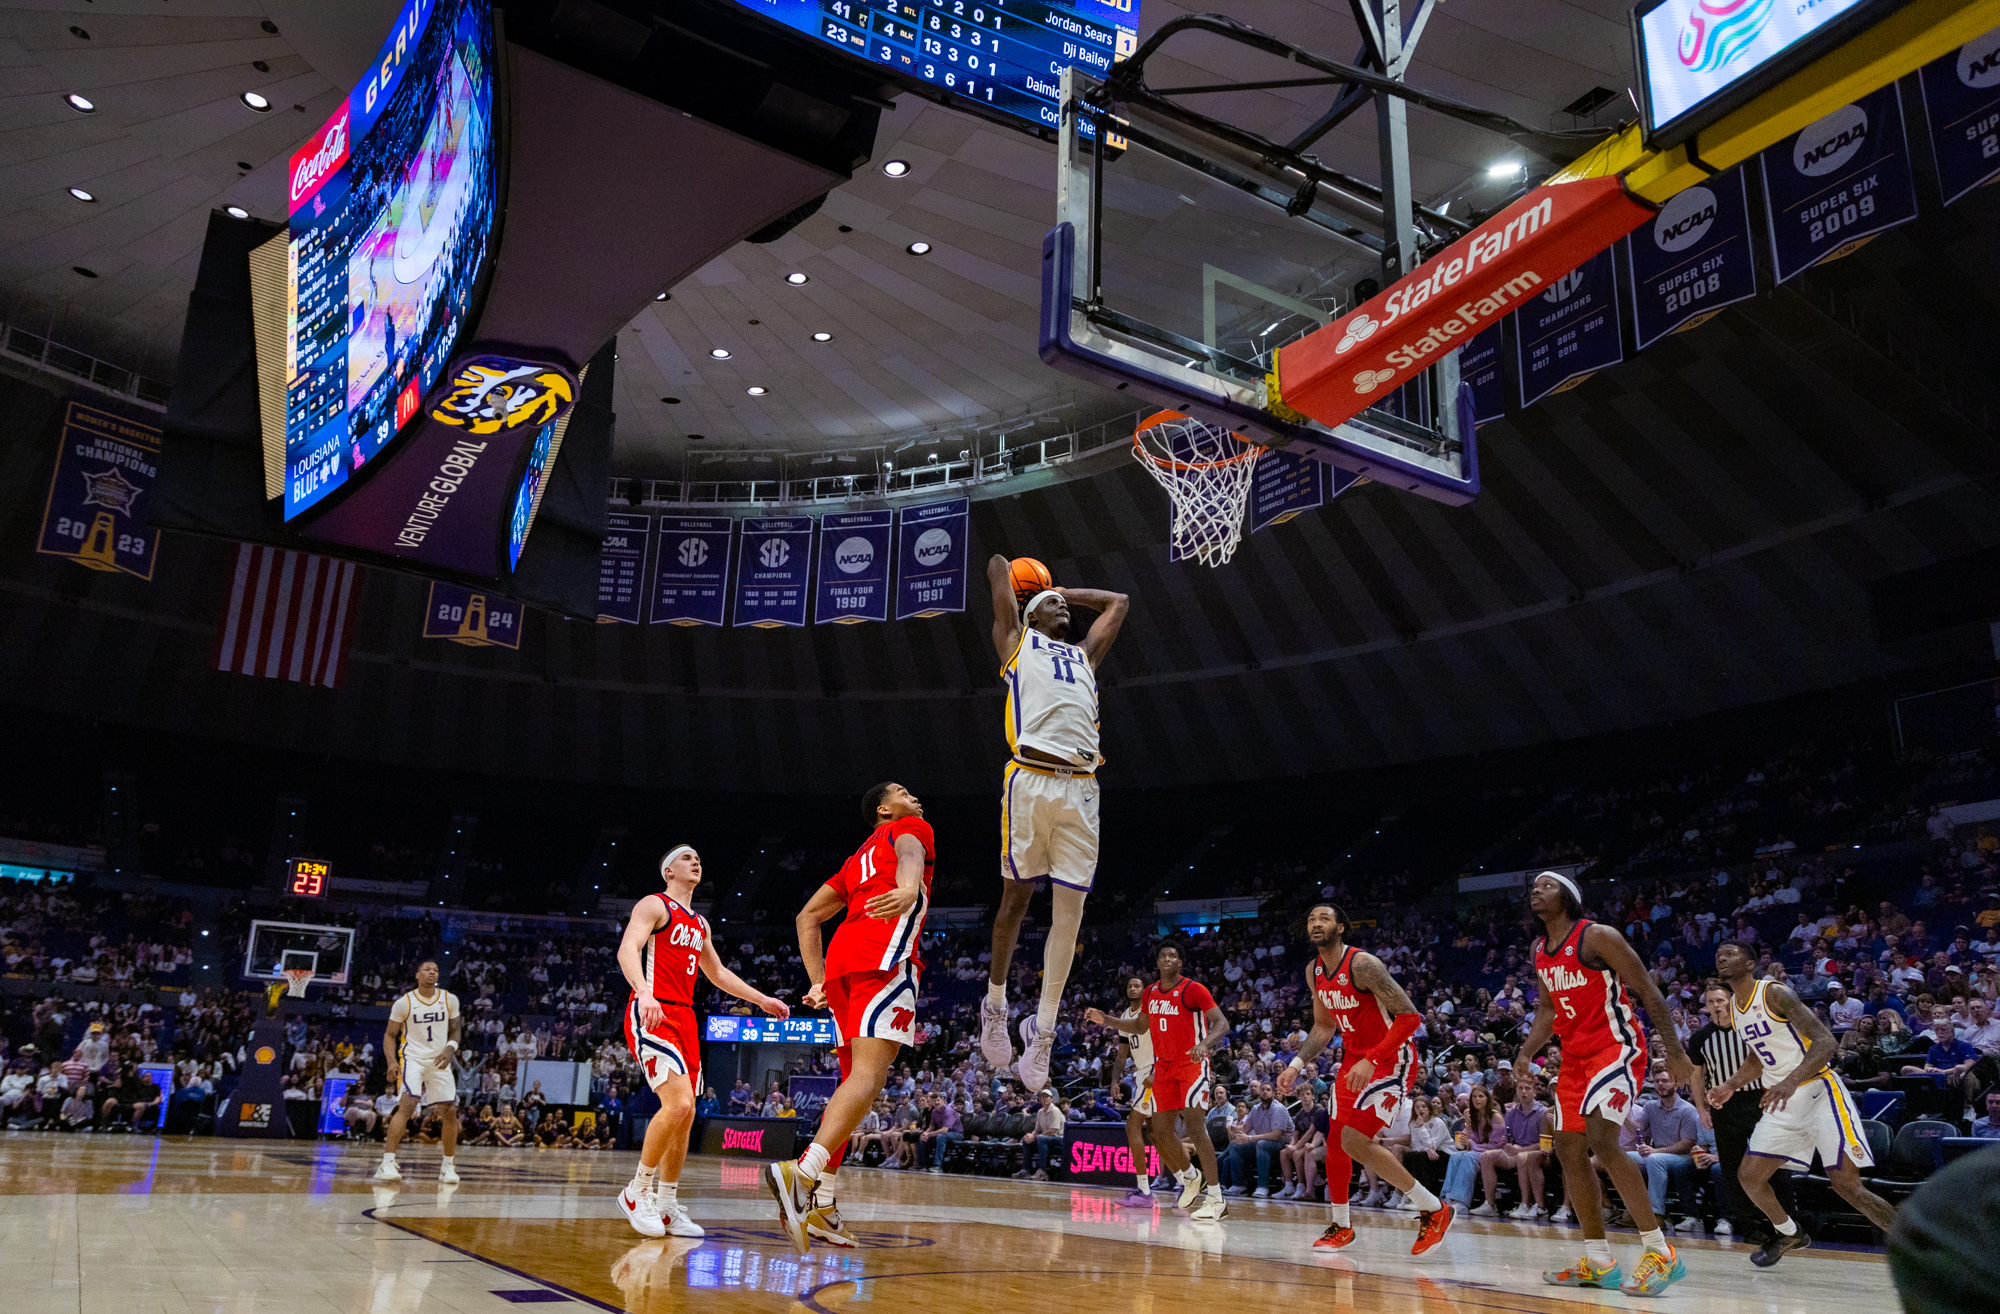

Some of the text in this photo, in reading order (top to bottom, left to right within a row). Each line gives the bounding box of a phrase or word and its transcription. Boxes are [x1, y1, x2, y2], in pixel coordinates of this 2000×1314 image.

[832, 1, 850, 20] 41
[859, 13, 868, 22] FT
[887, 0, 916, 17] 2 STL
[954, 2, 964, 16] 2
[974, 8, 984, 22] 0
[994, 16, 1001, 29] 1
[826, 24, 865, 46] 23 REB
[884, 23, 914, 40] 4 BLK
[930, 16, 998, 52] 8 3 3 1
[1046, 11, 1112, 45] Jordan Sears
[880, 46, 911, 64] 3 TO
[1063, 42, 1110, 70] Dji Bailey
[1124, 39, 1130, 51] 1
[366, 0, 426, 114] GEAU
[924, 38, 996, 76] 13 3 0 1
[924, 64, 994, 101] 3 6 1 1
[1026, 76, 1060, 100] Daimio
[1802, 122, 1868, 170] NCAA
[1800, 175, 1880, 224] SUPER SIX
[1661, 205, 1716, 246] NCAA
[1808, 194, 1876, 243] 2009
[1658, 253, 1724, 296] SUPER SIX
[1665, 272, 1720, 314] 2008
[1540, 294, 1592, 328] CHAMPIONS
[1532, 316, 1604, 358] 1981 2015 2016
[306, 355, 314, 366] 10
[1462, 348, 1494, 369] CHAMPIONS
[1532, 342, 1578, 372] 2017 2018
[1476, 370, 1495, 386] 2018
[338, 400, 344, 410] 0
[298, 430, 304, 441] 2
[376, 420, 389, 444] 39
[94, 438, 144, 460] NATIONAL
[294, 434, 340, 478] LOUISIANA
[76, 444, 157, 478] CHAMPIONS
[294, 467, 318, 504] BLUE
[394, 440, 488, 548] VENTURE GLOBAL
[1259, 478, 1280, 492] JACKSON
[1259, 482, 1297, 502] CLARE-KEARNEY
[918, 506, 950, 516] VOLLEYBALL
[1259, 498, 1285, 514] COURVILLE
[840, 516, 872, 524] VOLLEYBALL
[56, 516, 146, 556] 20 23
[678, 538, 710, 568] SEC
[760, 538, 791, 568] SEC
[838, 554, 872, 565] NCAA
[918, 544, 950, 558] NCAA
[754, 572, 792, 580] CHAMPIONS
[910, 578, 952, 590] FINAL FOUR
[830, 586, 874, 596] FINAL FOUR
[836, 596, 866, 608] 1990
[917, 588, 944, 603] 1991
[438, 604, 513, 629] 20 24
[1032, 635, 1084, 664] LSU
[1052, 656, 1076, 684] 11
[297, 862, 328, 876] 17:34
[860, 845, 876, 884] 11
[294, 874, 322, 895] 23
[670, 922, 691, 946] Ole
[1024, 932, 1043, 940] (225)
[686, 954, 696, 976] 3
[1550, 965, 1588, 992] Miss
[1149, 999, 1180, 1016] Ole Miss
[1329, 990, 1360, 1010] Miss
[1558, 996, 1577, 1020] 5
[413, 1012, 446, 1024] LSU
[768, 1022, 774, 1031] 0
[784, 1020, 812, 1032] 17:35
[820, 1024, 826, 1032] 2
[1159, 1018, 1168, 1032] 0
[1336, 1014, 1356, 1032] 14
[426, 1026, 433, 1042] 1
[742, 1028, 758, 1040] 39
[1754, 1042, 1776, 1066] 5
[722, 1127, 764, 1152] SEATGEEK
